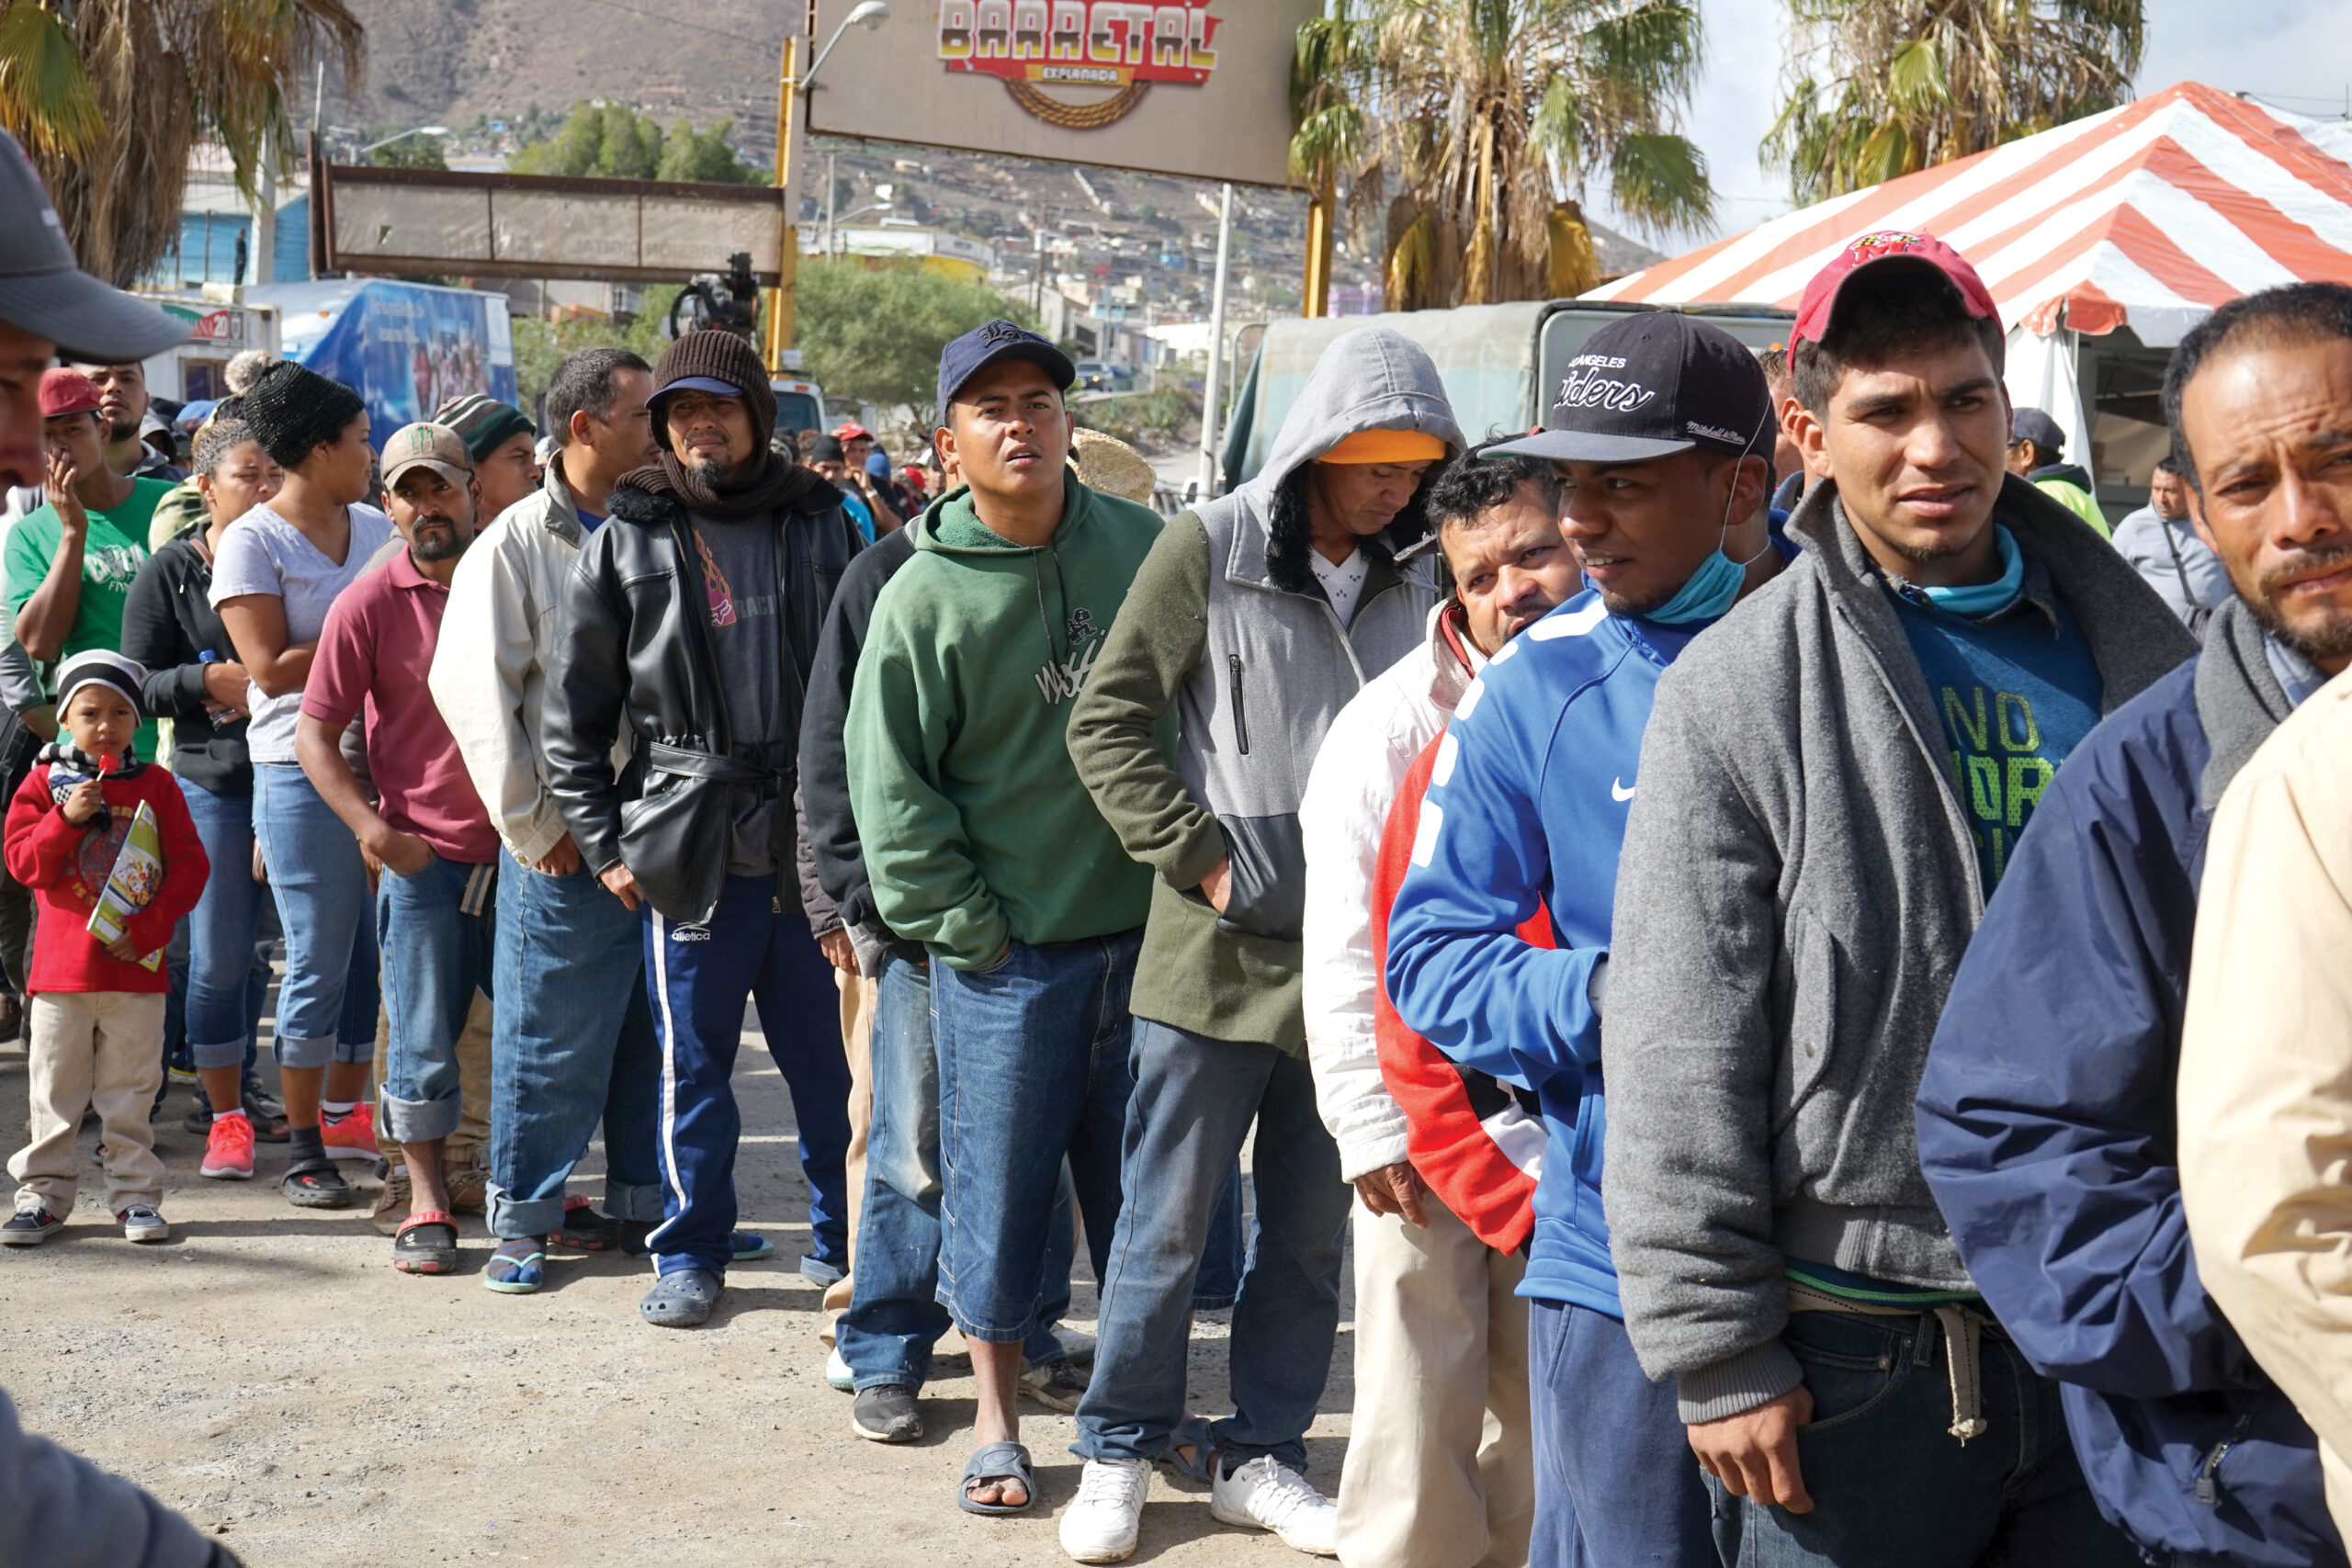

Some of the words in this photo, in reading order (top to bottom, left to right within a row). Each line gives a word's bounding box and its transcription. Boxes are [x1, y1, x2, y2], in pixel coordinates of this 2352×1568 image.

[937, 0, 1217, 70] BARRETAL
[1042, 67, 1118, 83] EXPLANADA
[213, 314, 228, 337] 20
[1578, 354, 1626, 368] ANGELES
[1941, 687, 2041, 751] NO
